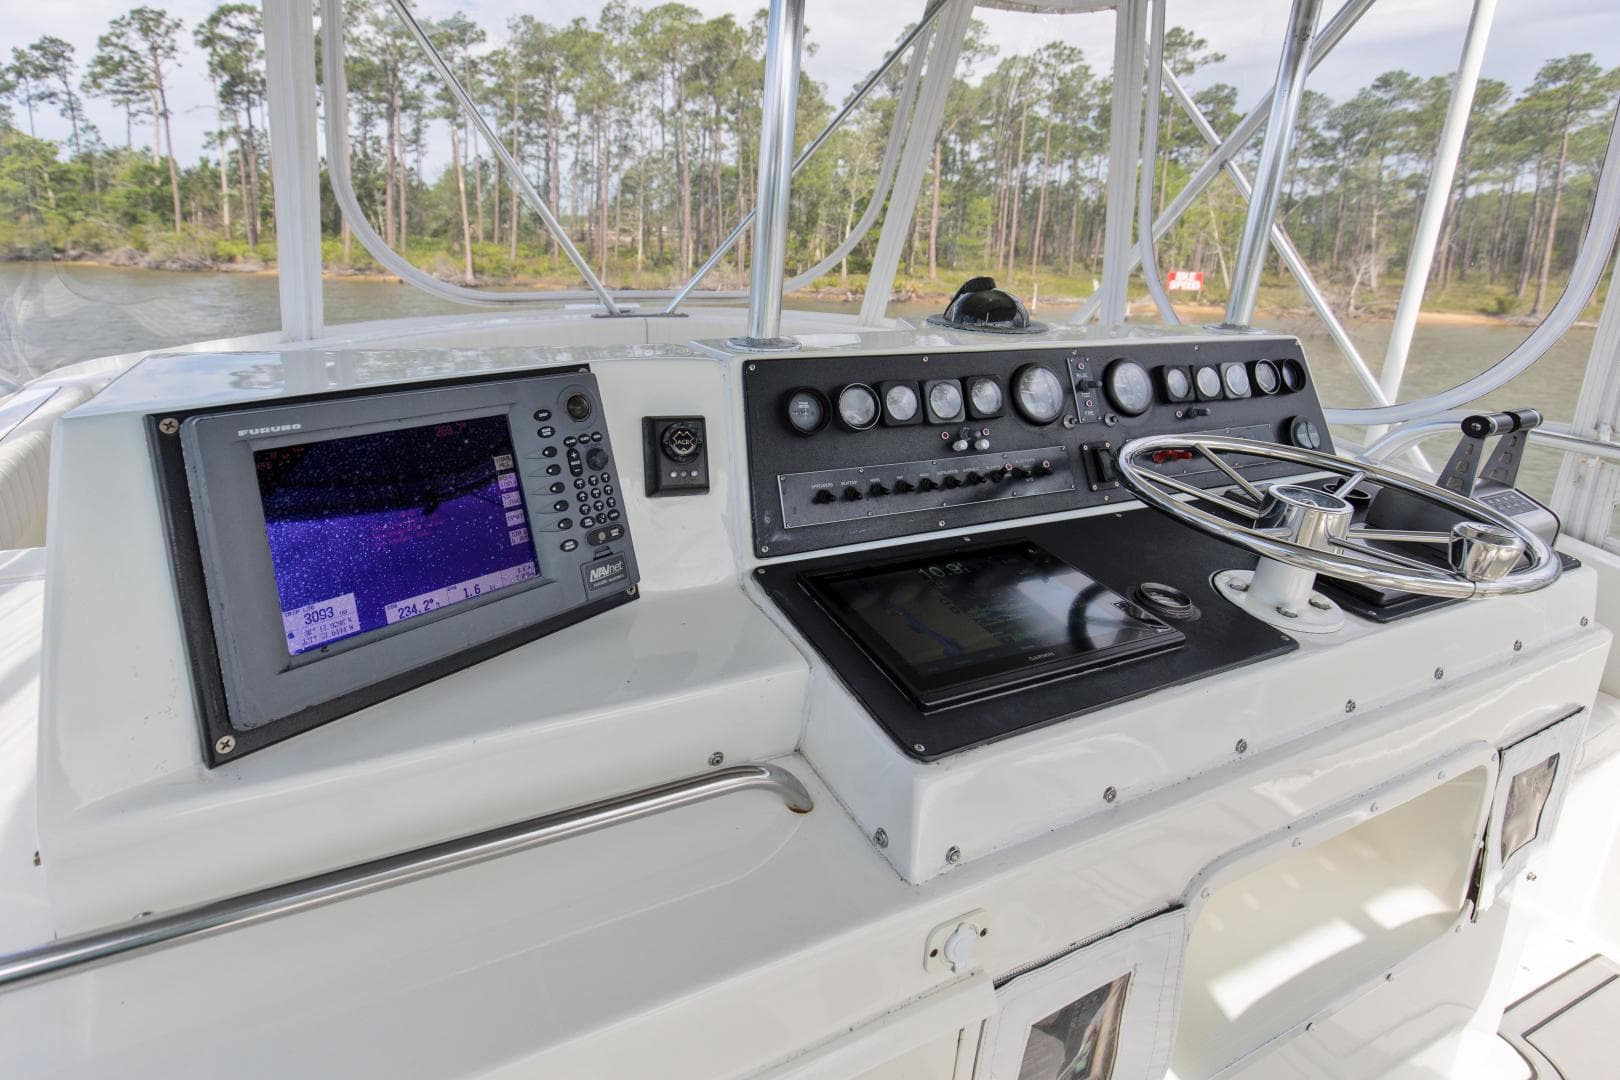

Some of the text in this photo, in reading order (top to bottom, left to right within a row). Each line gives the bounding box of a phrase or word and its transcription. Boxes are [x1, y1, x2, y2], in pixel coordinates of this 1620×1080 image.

[238, 423, 302, 437] FURUNO
[589, 561, 623, 583] NAVnet
[463, 584, 481, 598] 1.6
[304, 606, 334, 625] 3093
[398, 598, 434, 619] 234.2°
